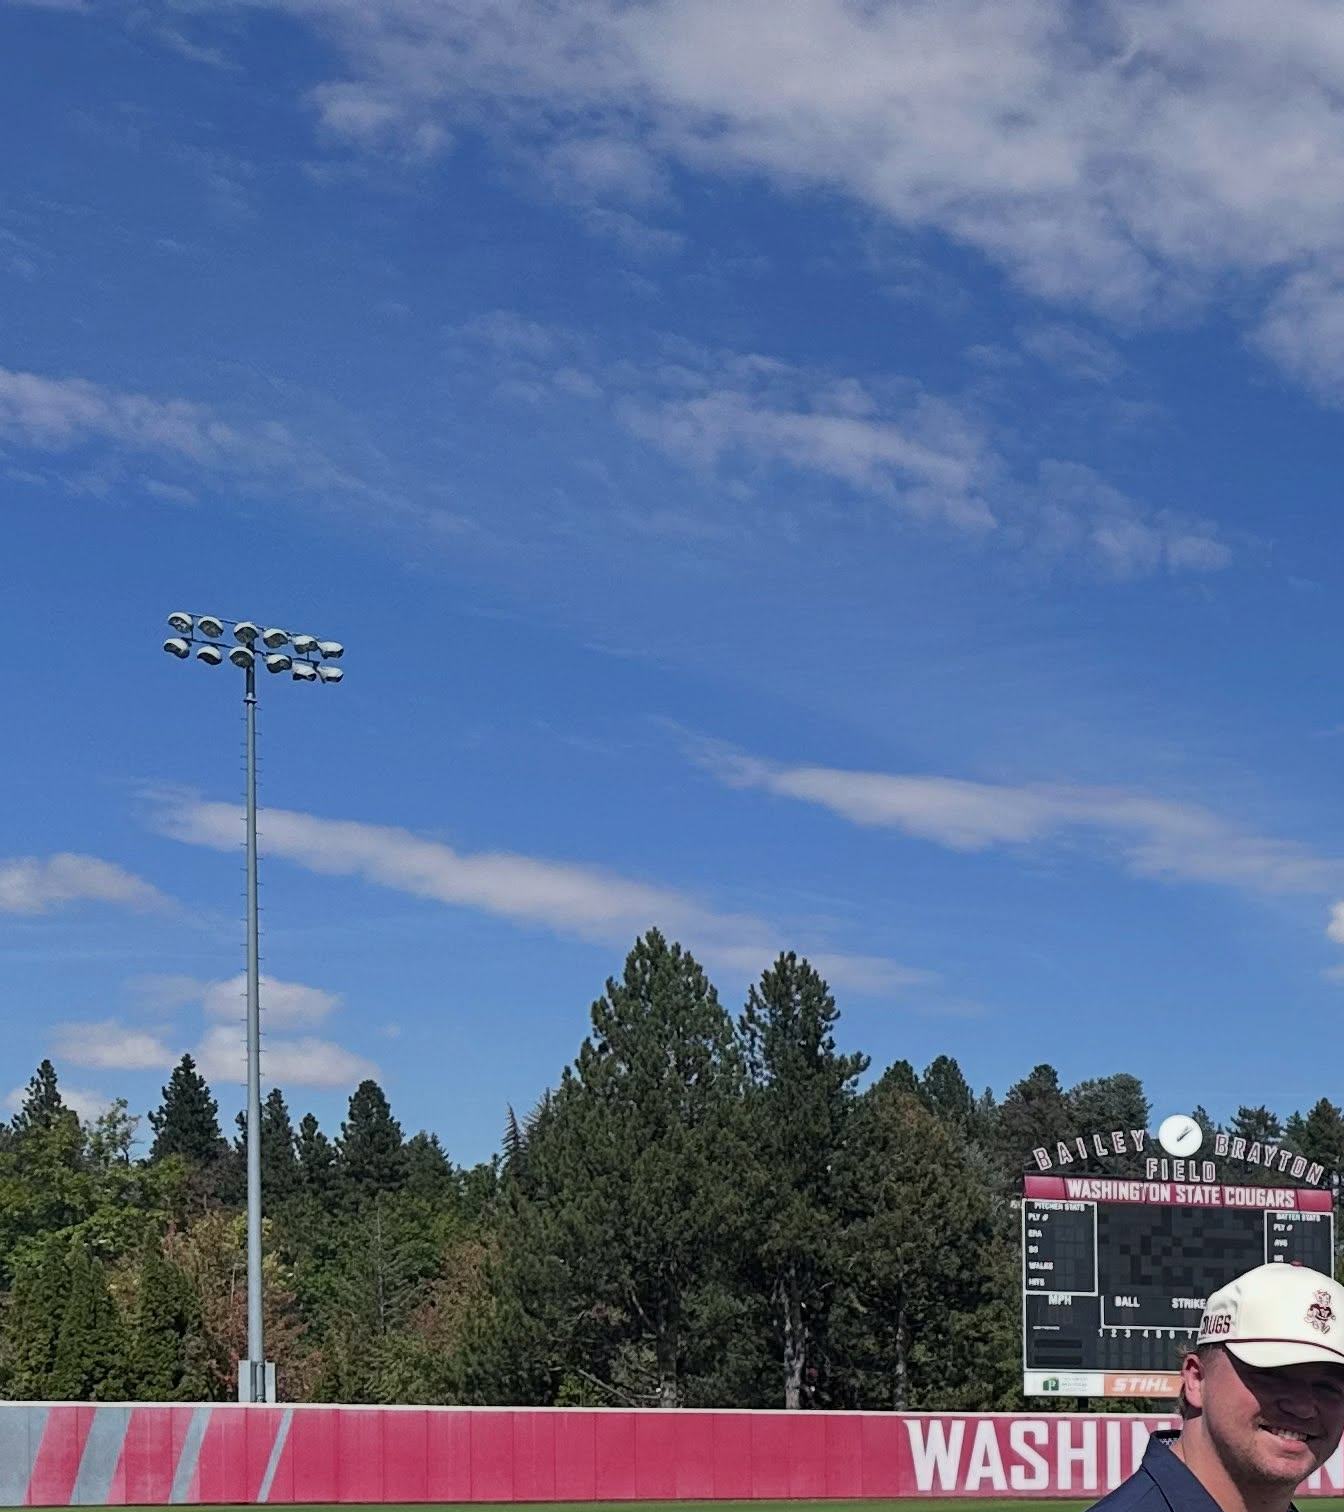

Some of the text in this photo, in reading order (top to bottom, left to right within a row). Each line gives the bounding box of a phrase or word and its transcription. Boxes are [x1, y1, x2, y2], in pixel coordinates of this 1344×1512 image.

[1032, 1129, 1325, 1186] BAILEY BRAYTON
[1146, 1158, 1216, 1183] FIELD
[1067, 1178, 1295, 1208] WASHINGTON STATE COUGARS
[1048, 1295, 1072, 1305] MPH
[1115, 1296, 1141, 1308] BALL
[1171, 1298, 1207, 1310] STRIKE
[1098, 1328, 1104, 1338] 1
[1111, 1329, 1118, 1338] 2
[1125, 1329, 1131, 1339] 3
[1143, 1329, 1149, 1339] 4
[1187, 1330, 1193, 1340] 7
[1111, 1377, 1174, 1394] STIHL
